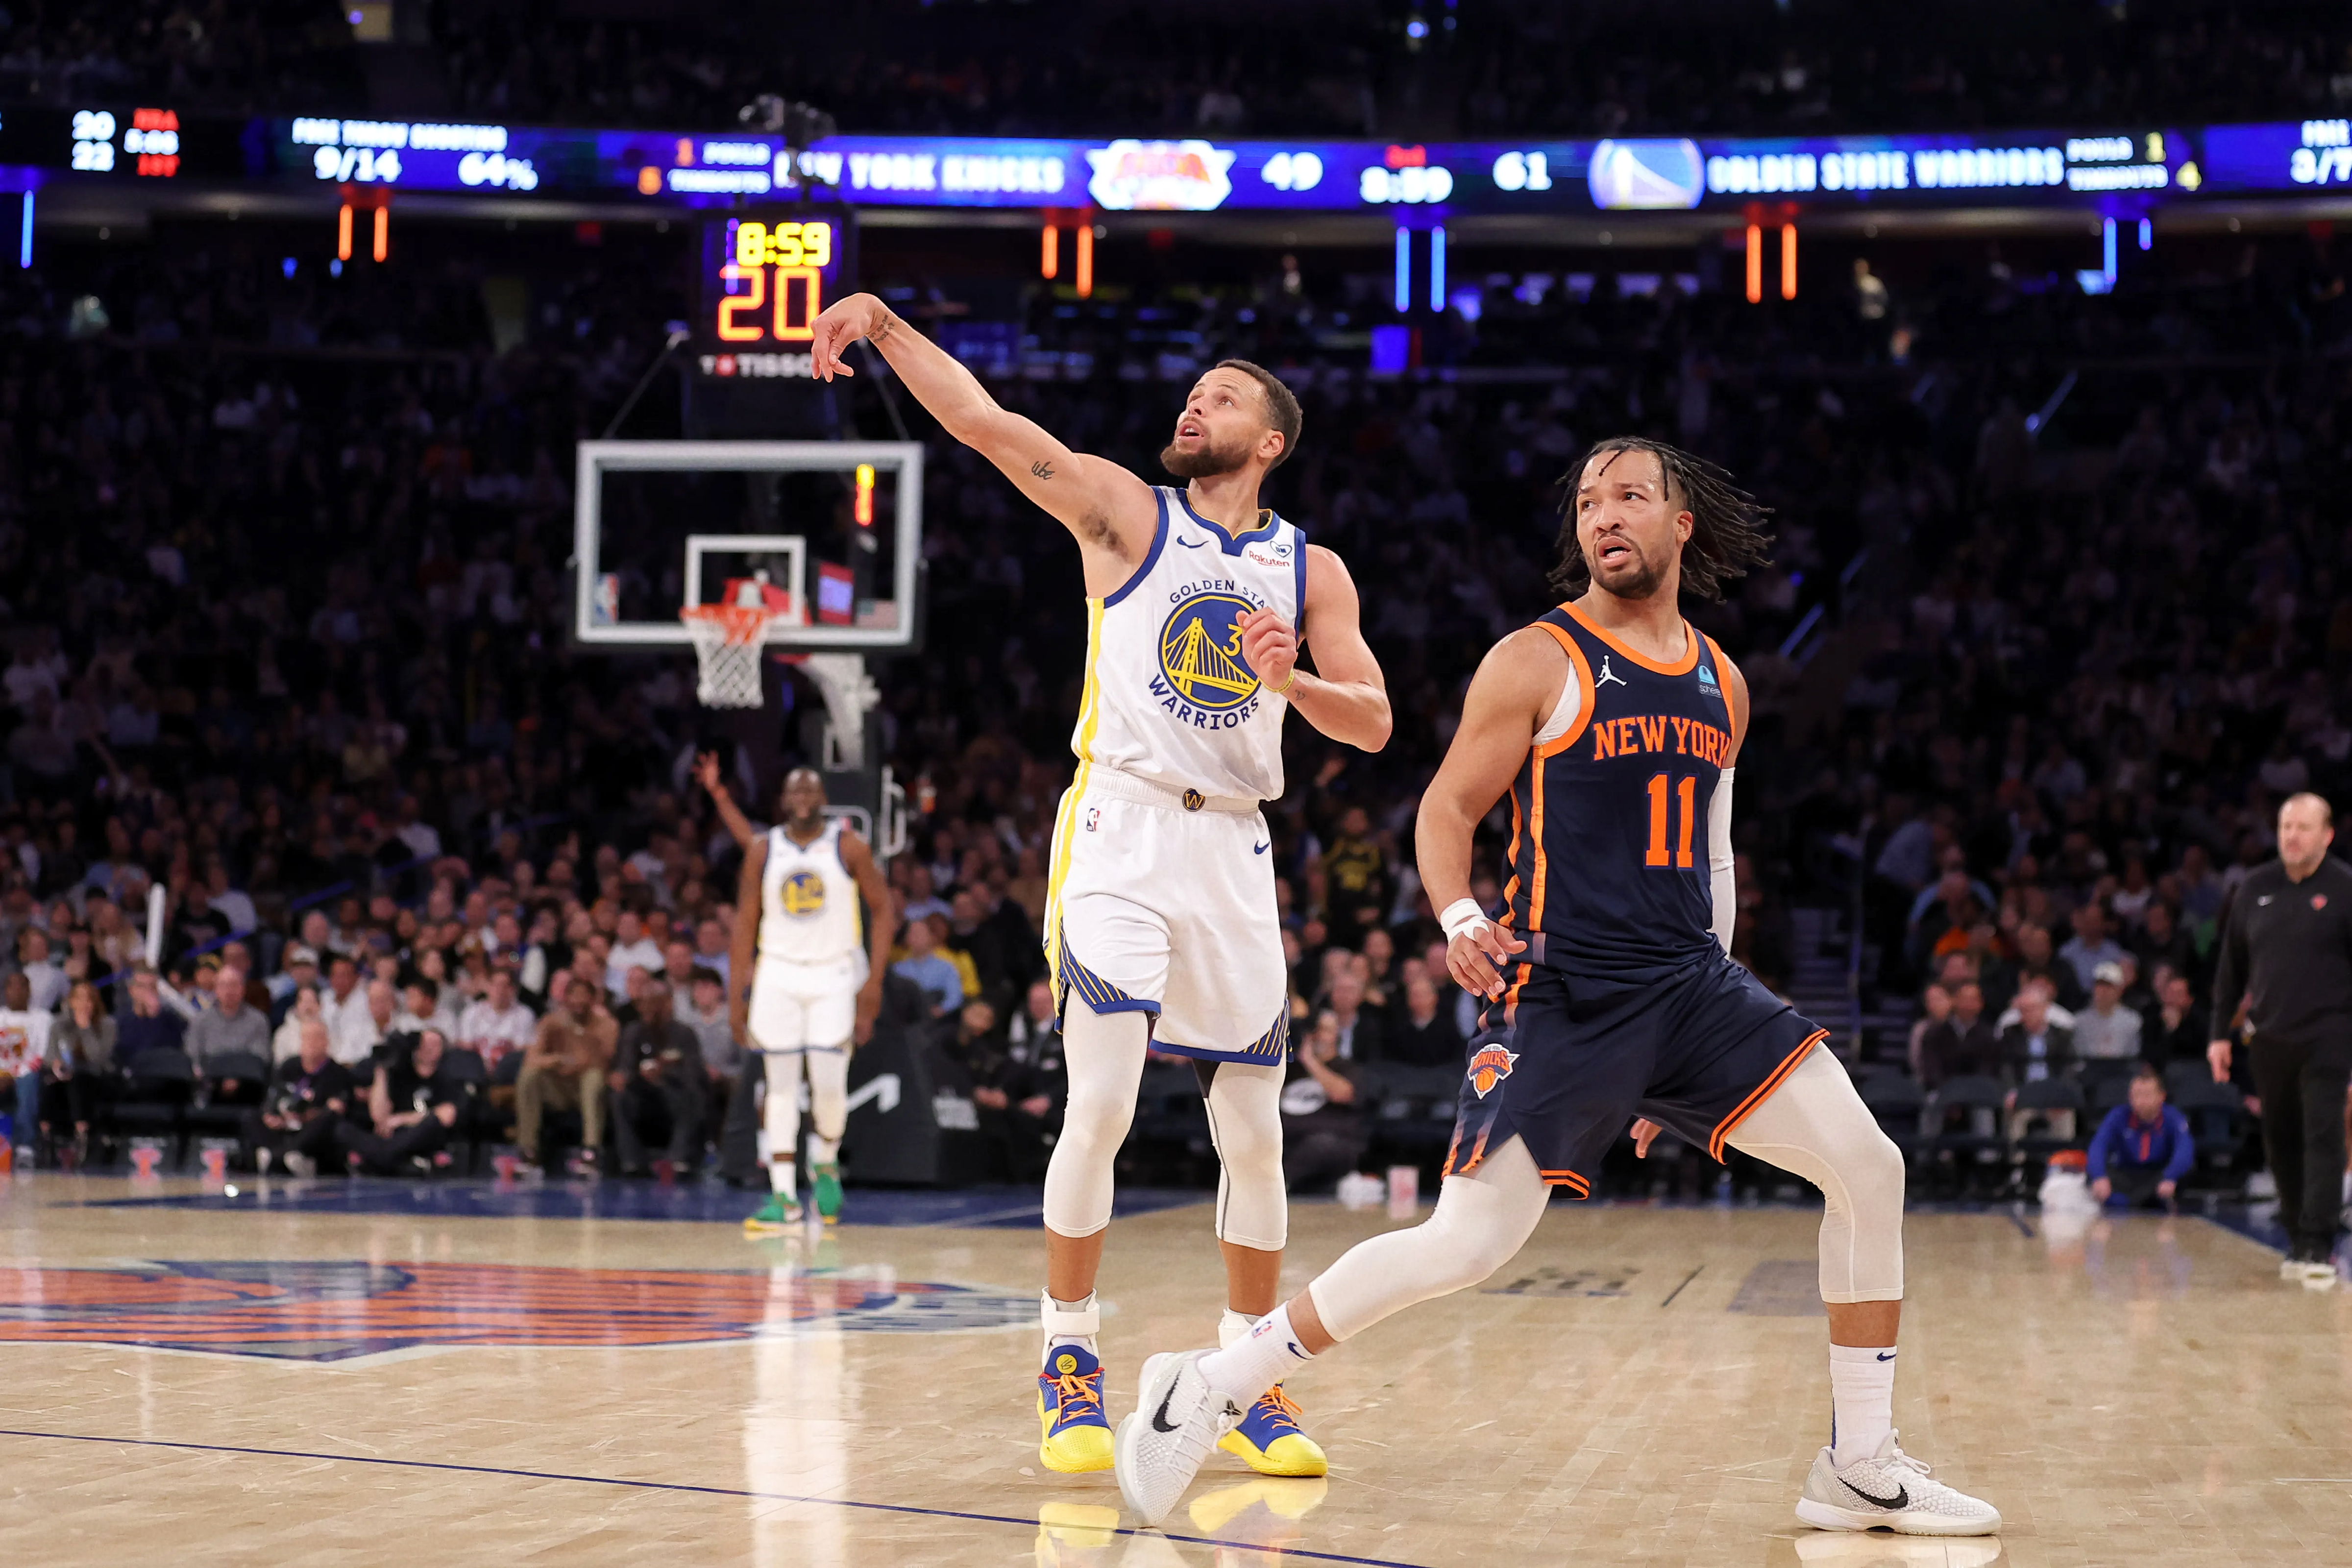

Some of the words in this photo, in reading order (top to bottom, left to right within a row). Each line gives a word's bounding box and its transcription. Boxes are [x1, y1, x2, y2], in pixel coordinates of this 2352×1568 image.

[72, 110, 116, 141] 20
[72, 140, 115, 172] 22
[314, 145, 402, 182] 9/14
[458, 152, 538, 190] 64%
[848, 152, 936, 190] YORK
[941, 154, 1064, 194] KNICKS
[1261, 152, 1323, 191] 49
[1493, 150, 1552, 191] 61
[1706, 153, 1817, 193] GOLDEN
[1820, 150, 1910, 191] STATE
[1913, 147, 2064, 188] WARRIORS
[737, 222, 831, 267] 8:59
[718, 266, 821, 341] 20
[737, 353, 815, 378] TISSO
[1249, 550, 1290, 567] Rakuten
[1170, 579, 1235, 603] GOLDEN
[1242, 587, 1266, 609] STA
[1223, 623, 1243, 657] 3
[1149, 673, 1259, 730] WARRIORS
[1699, 685, 1721, 696] sphere
[1592, 715, 1666, 760] NEW
[1671, 716, 1731, 769] YORK
[1644, 772, 1697, 869] 11
[1470, 1050, 1511, 1073] KNICKS
